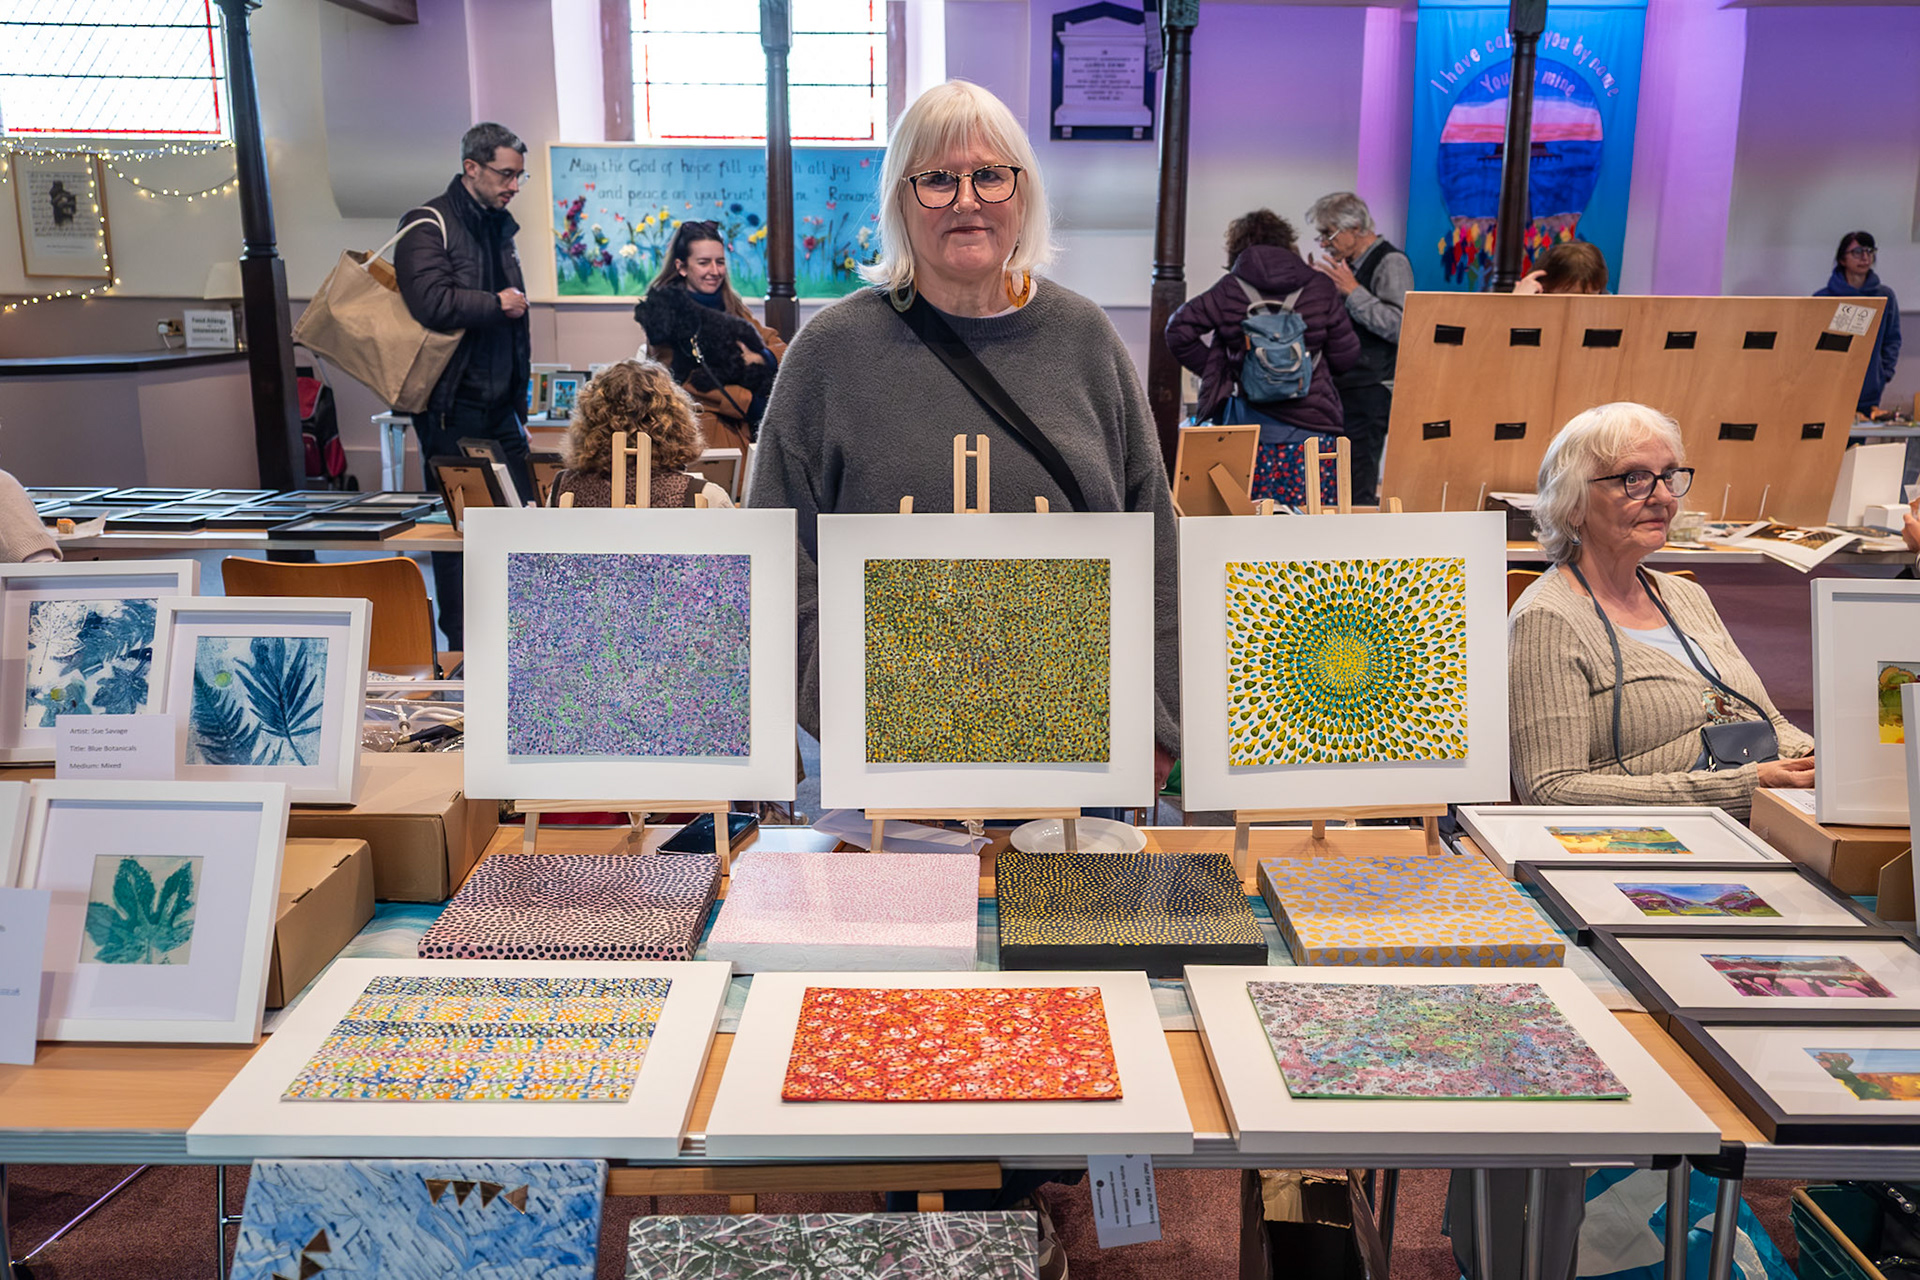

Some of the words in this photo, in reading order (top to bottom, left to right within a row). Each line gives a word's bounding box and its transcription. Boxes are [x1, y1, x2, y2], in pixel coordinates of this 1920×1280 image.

[1430, 79, 1448, 94] I
[1439, 48, 1481, 84] have
[1543, 30, 1570, 50] you
[1572, 35, 1592, 65] by
[1588, 57, 1619, 97] name
[1480, 73, 1510, 94] You
[1541, 70, 1575, 97] mine
[569, 158, 598, 179] May
[601, 158, 624, 173] the
[628, 158, 656, 177] God
[660, 161, 673, 177] of
[680, 158, 712, 180] hope
[719, 159, 742, 178] fill
[807, 160, 827, 175] all
[831, 162, 850, 181] joy
[598, 184, 623, 200] and
[628, 188, 668, 206] peace
[672, 189, 687, 200] as
[693, 188, 718, 206] you
[721, 187, 754, 201] trust
